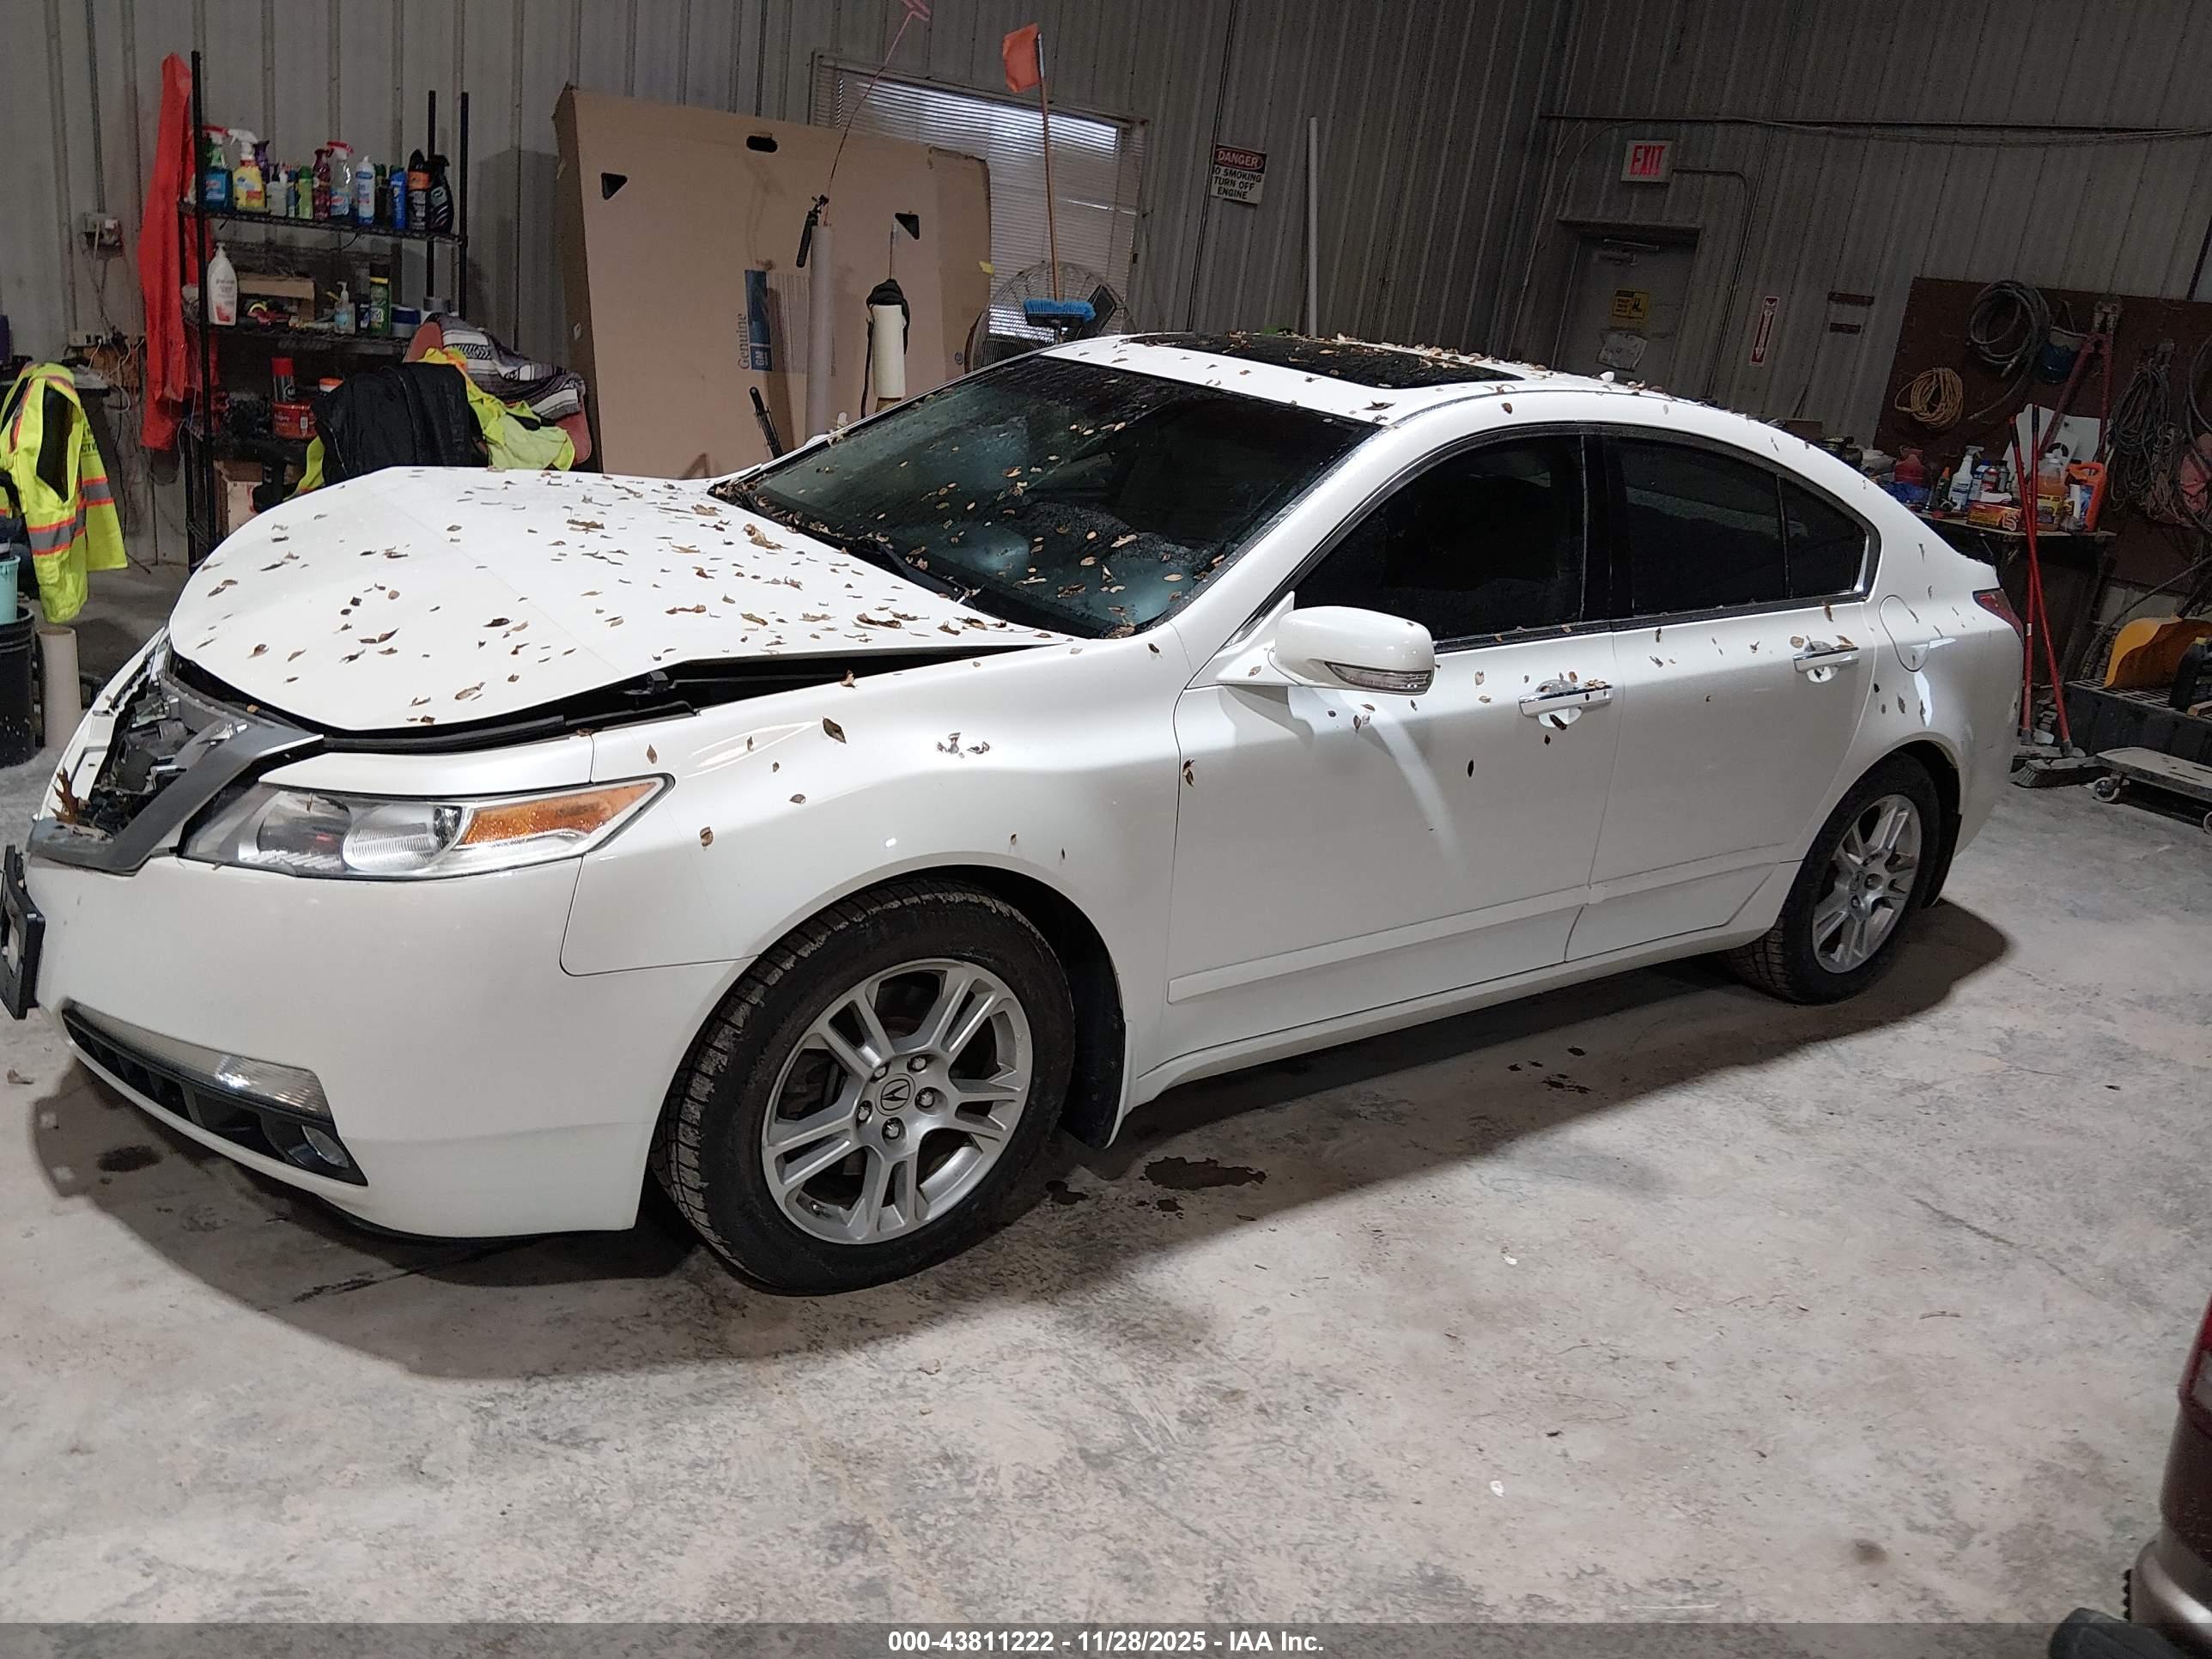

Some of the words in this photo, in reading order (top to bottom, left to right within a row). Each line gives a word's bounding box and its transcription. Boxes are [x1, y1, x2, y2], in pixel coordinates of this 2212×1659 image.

[1218, 150, 1258, 167] DANGER
[1630, 144, 1666, 175] EXIT
[1213, 176, 1237, 187] TURN
[1238, 181, 1255, 191] OFF
[1223, 168, 1261, 183] SMOKING
[1217, 186, 1248, 199] ENGINE
[736, 313, 750, 370] Genuine
[755, 350, 764, 366] GM
